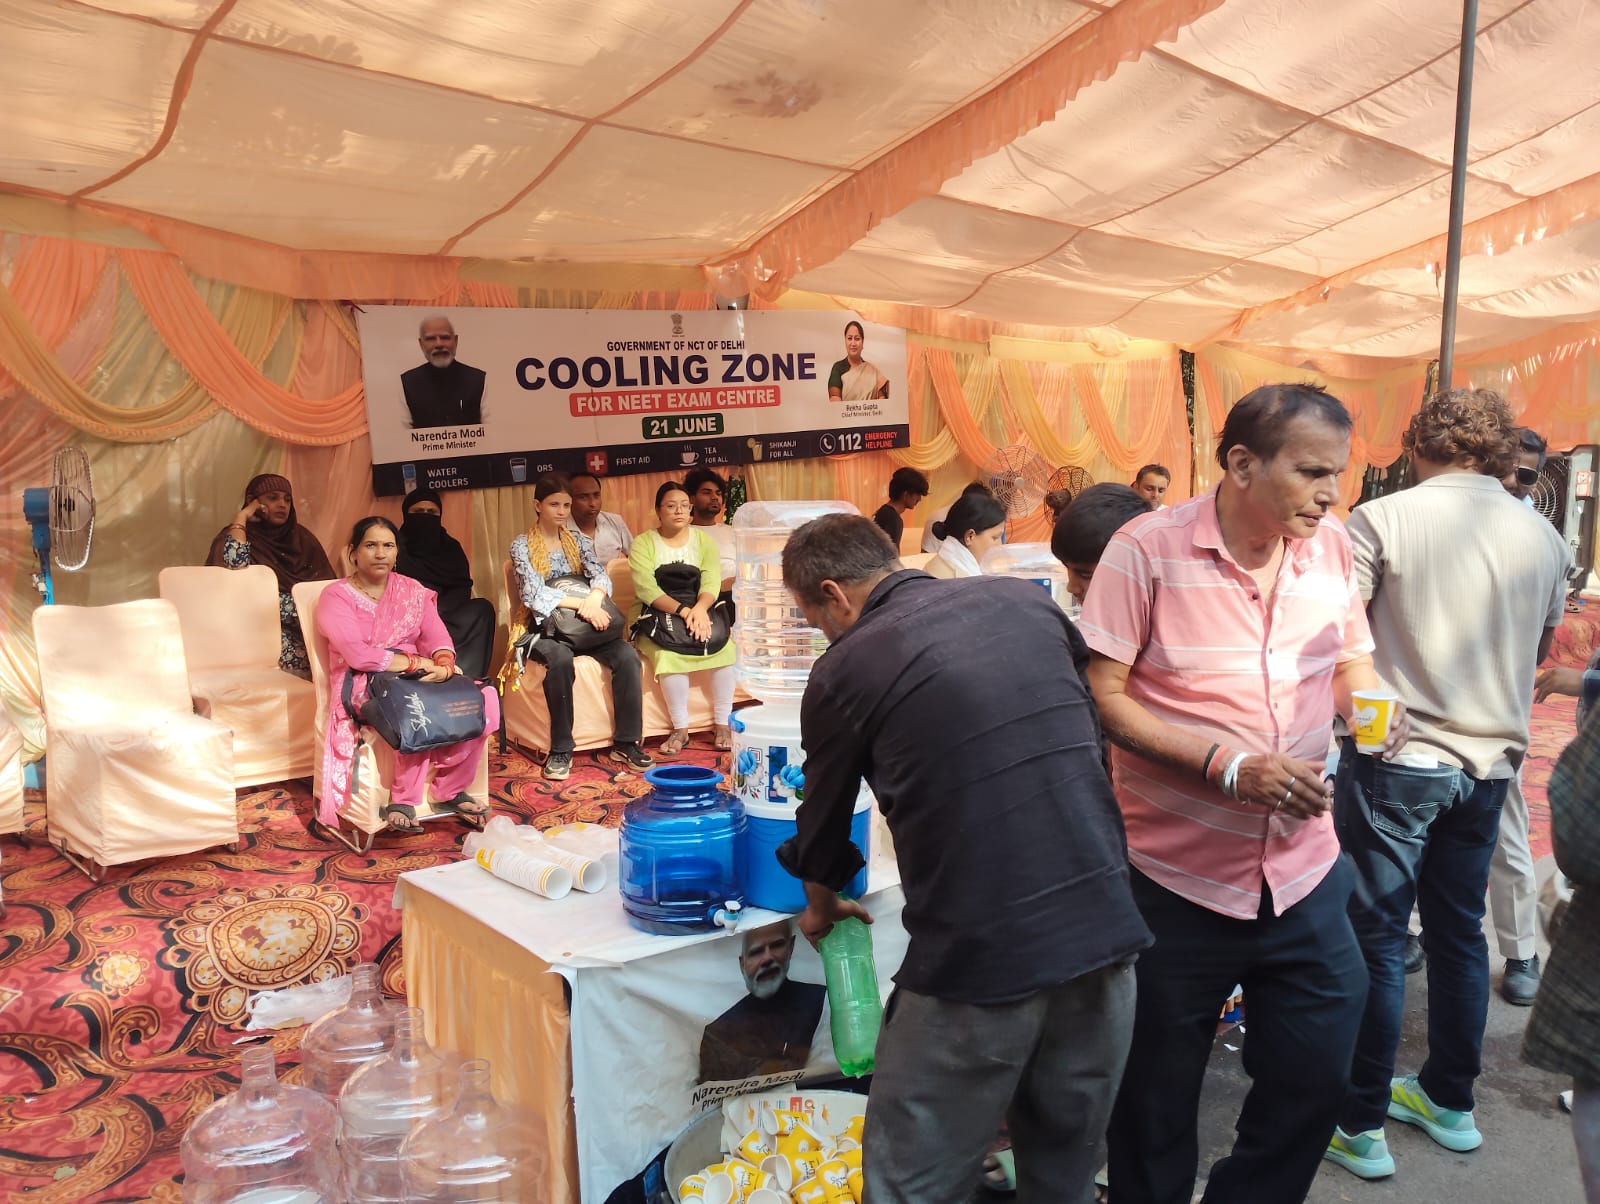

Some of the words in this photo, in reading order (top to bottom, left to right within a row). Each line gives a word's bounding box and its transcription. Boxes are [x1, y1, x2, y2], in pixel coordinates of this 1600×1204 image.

[607, 340, 671, 352] GOVERNMENT
[673, 340, 685, 351] OF
[688, 340, 704, 351] NCT
[707, 340, 719, 350] OF
[721, 340, 745, 350] DELHI
[515, 354, 709, 390] COOLING
[721, 353, 817, 383] ZONE
[576, 396, 613, 414] FOR
[618, 393, 663, 411] NEET
[667, 391, 712, 408] EXAM
[716, 389, 775, 406] CENTRE
[846, 404, 861, 412] Rekha
[863, 403, 878, 411] Gupta
[650, 419, 669, 436] 21
[675, 417, 717, 434] JUNE
[411, 428, 457, 443] Narendra
[460, 427, 485, 439] Modi
[865, 431, 898, 441] EMERGENCY
[422, 442, 444, 452] Prime
[446, 440, 476, 450] Minister
[769, 441, 797, 449] SHIKANJI
[838, 433, 862, 451] 112
[865, 440, 893, 449] HELPLINE
[704, 447, 717, 455] TEA
[616, 457, 637, 466] FIRST
[638, 456, 651, 464] AID
[427, 467, 457, 478] WATER
[536, 464, 553, 473] ORS
[428, 478, 469, 490] COOLERS
[691, 1079, 759, 1106] Narendra
[765, 1071, 806, 1086] Modi
